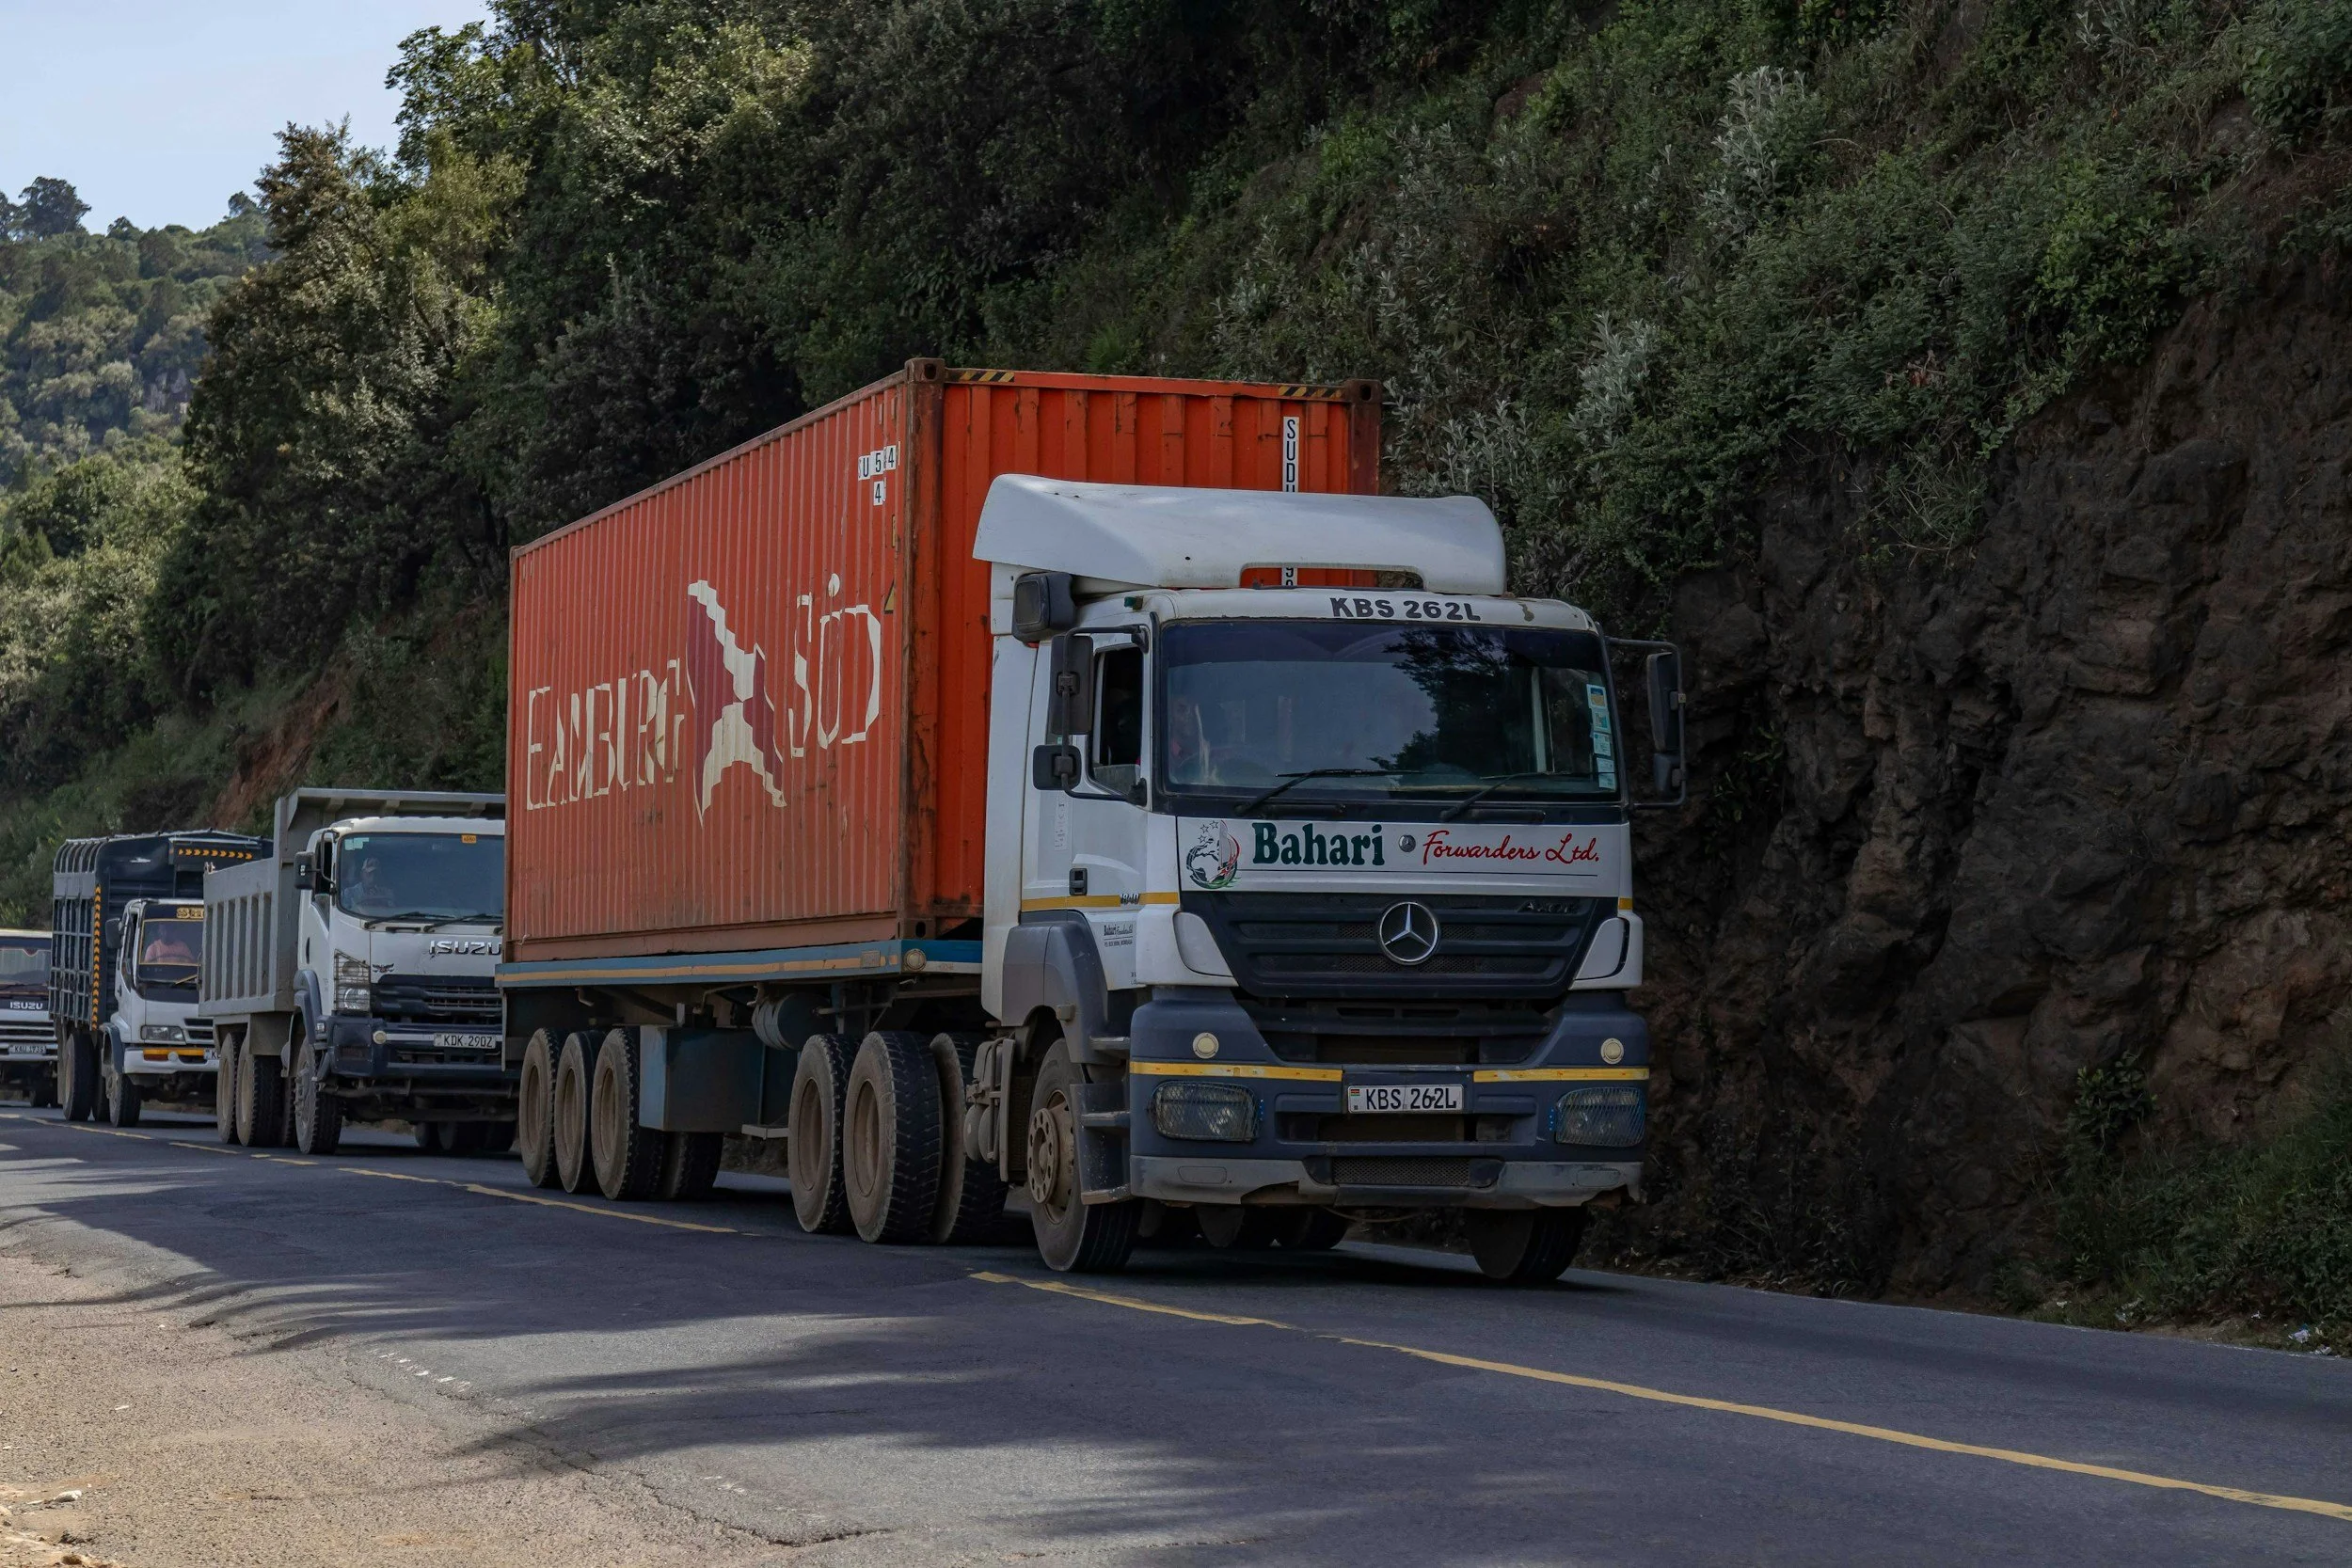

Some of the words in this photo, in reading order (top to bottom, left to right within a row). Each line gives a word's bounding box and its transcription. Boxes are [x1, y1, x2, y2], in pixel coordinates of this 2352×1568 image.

[1329, 597, 1395, 618] KBS
[1403, 600, 1481, 621] 262L
[1251, 822, 1385, 865] Bahari
[1422, 830, 1540, 865] Forwarders
[1545, 832, 1599, 864] Ltd.
[429, 940, 502, 956] ISUZU
[9, 1001, 43, 1010] ISUZU
[443, 1036, 463, 1047] KDK
[469, 1036, 494, 1048] 290Z
[1366, 1088, 1402, 1110] KBS
[1410, 1087, 1457, 1110] 262L
